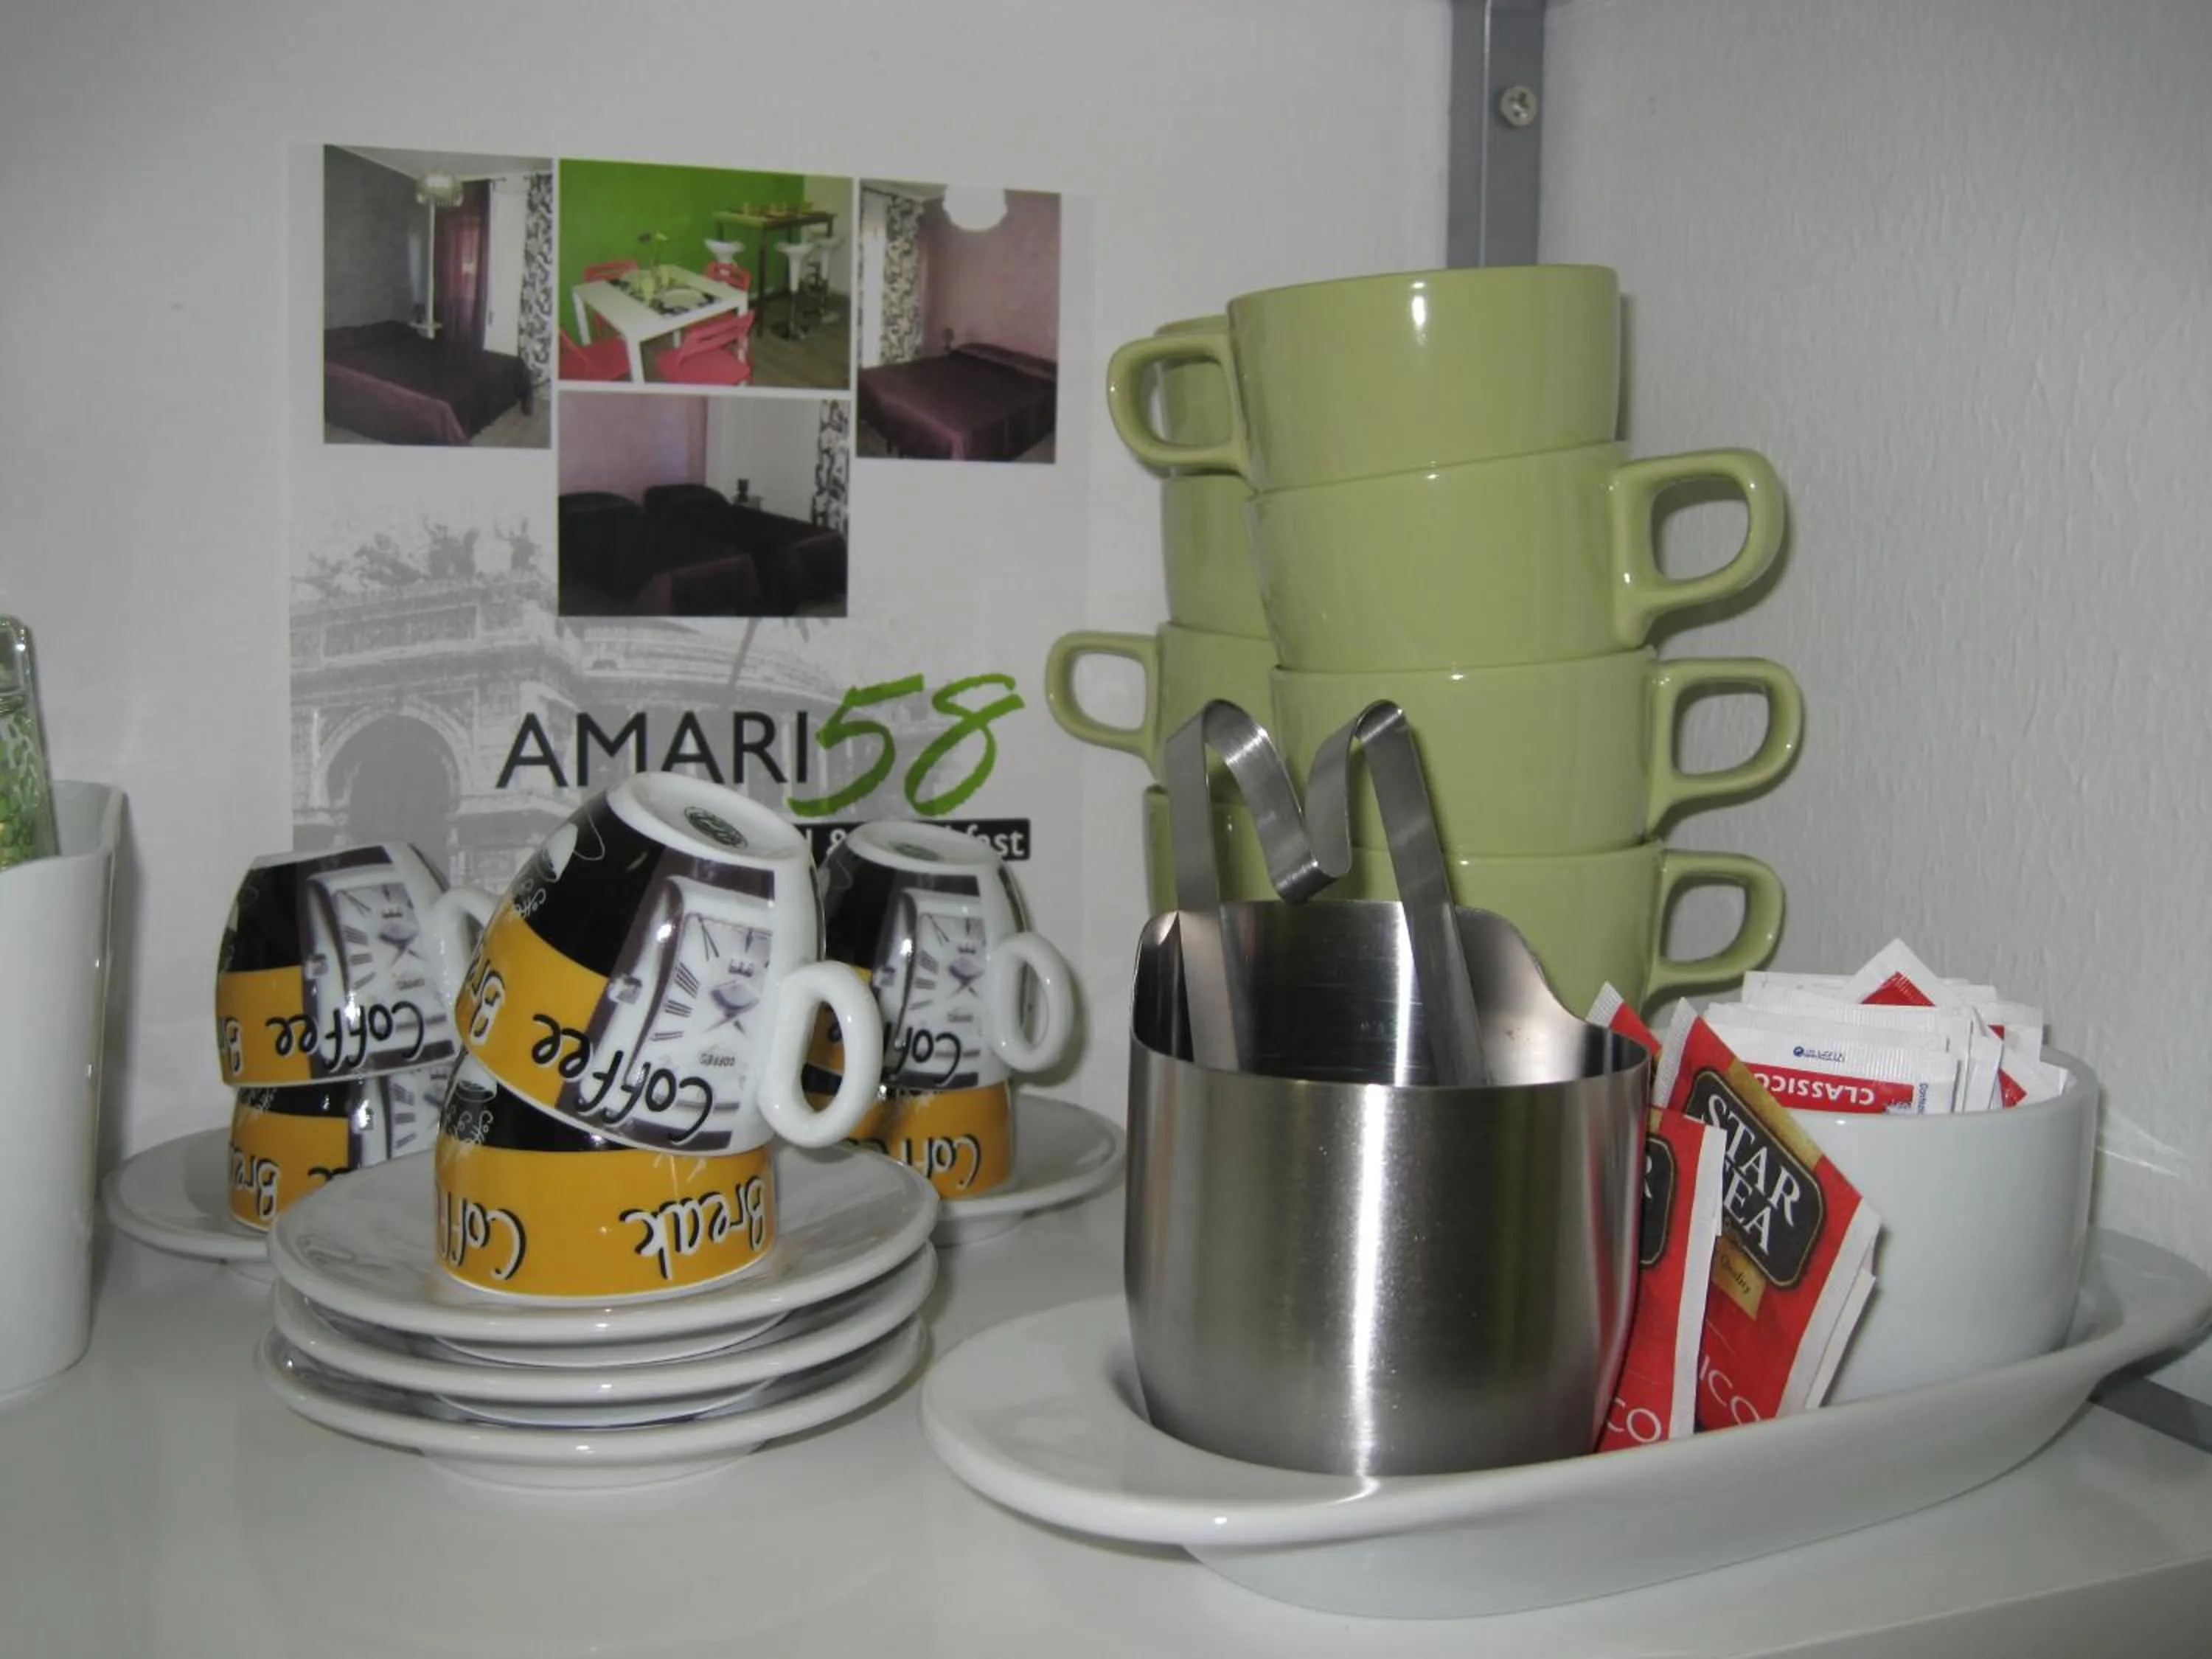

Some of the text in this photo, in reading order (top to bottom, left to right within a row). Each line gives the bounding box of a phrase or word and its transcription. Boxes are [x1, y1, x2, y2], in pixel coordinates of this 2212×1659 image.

[265, 1001, 425, 1071] Coffee
[532, 1013, 714, 1145] Coffee
[1700, 1093, 1801, 1228] STAR
[1721, 1158, 1772, 1257] EA
[619, 1175, 765, 1279] Break
